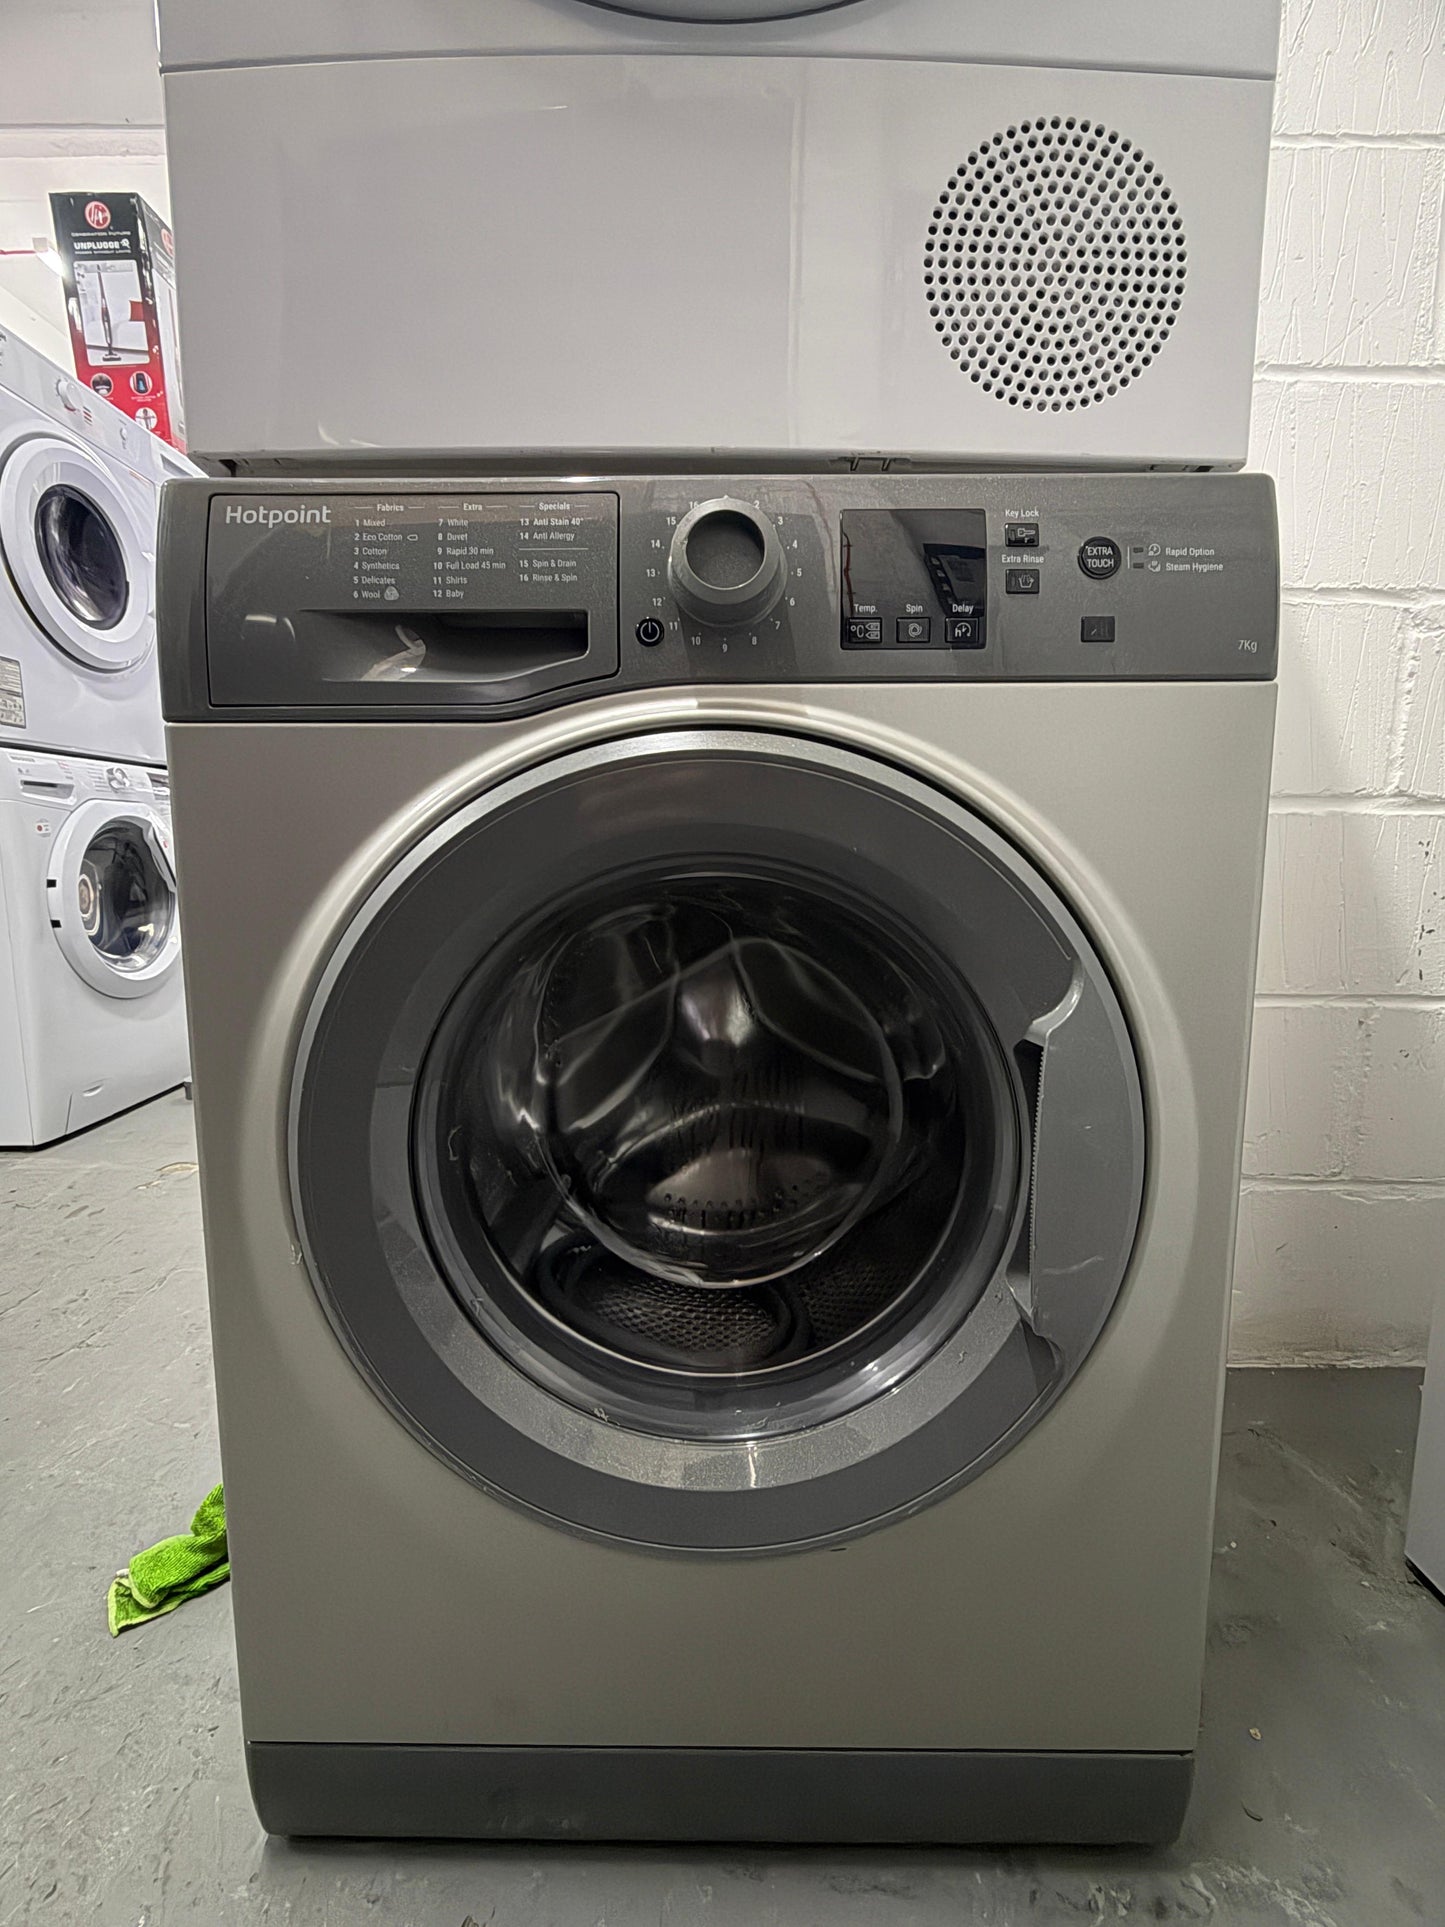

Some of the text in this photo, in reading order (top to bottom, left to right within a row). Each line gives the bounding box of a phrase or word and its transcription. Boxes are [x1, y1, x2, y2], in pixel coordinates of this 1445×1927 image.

[377, 503, 404, 512] Fabrics
[463, 503, 482, 512] Extra
[539, 502, 570, 512] Specials
[754, 500, 760, 508] 2
[225, 505, 332, 529] Hotpoint
[1005, 509, 1039, 519] Key Lock
[363, 518, 386, 527] Mixed
[438, 519, 468, 527] 7 White
[520, 518, 529, 526] 13
[533, 517, 548, 526] Anti
[550, 517, 569, 526] Stain
[666, 517, 676, 526] 15
[778, 517, 783, 525] 3
[363, 533, 377, 541] Eco
[378, 533, 403, 541] Cotton
[447, 533, 468, 541] Duvet
[520, 531, 575, 542] 14 Anti Allergy
[651, 540, 661, 549] 14
[792, 540, 798, 548] 4
[362, 547, 387, 556] Cotton
[437, 547, 494, 557] 9 Rapid 30 min
[1087, 546, 1113, 556] EXTRA
[1166, 547, 1215, 558] Rapid Option
[1002, 555, 1044, 563] Extra Rinse
[1087, 558, 1114, 568] TOUCH
[354, 561, 400, 571] 4 Synthetics
[433, 561, 506, 570] 10 Full Load 45 min
[520, 559, 577, 569] 15 Spin & Drain
[1166, 563, 1224, 573] Steam Hygiene
[646, 569, 656, 578] 13
[797, 568, 802, 576] 5
[354, 576, 395, 585] 5 Delicates
[433, 576, 468, 584] 11 Shirts
[520, 574, 578, 584] 16 Rinse & Spin
[362, 591, 380, 599] Wool
[433, 589, 464, 599] 12 Baby
[652, 598, 662, 607] 12
[790, 598, 795, 606] 6
[854, 604, 878, 614] Temp.
[906, 604, 923, 614] Spin
[952, 604, 974, 614] Delay
[669, 622, 678, 630] 11
[775, 622, 781, 630] 7
[691, 637, 701, 646] 10
[752, 637, 757, 645] 8
[1238, 639, 1257, 652] 7Kg
[722, 644, 728, 652] 9
